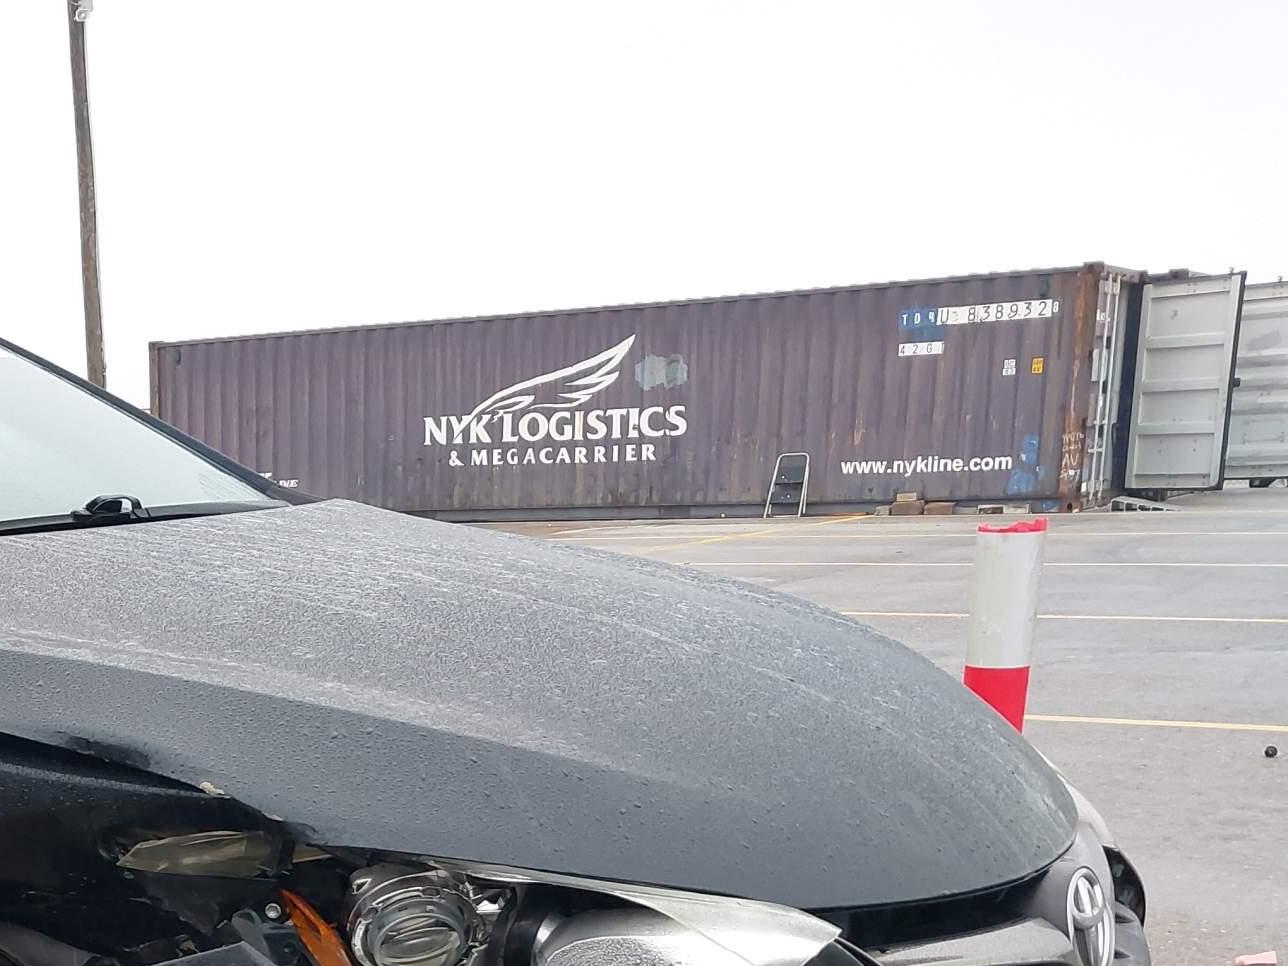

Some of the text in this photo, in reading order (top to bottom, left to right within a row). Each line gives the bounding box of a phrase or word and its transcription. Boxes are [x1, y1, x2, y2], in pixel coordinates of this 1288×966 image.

[423, 405, 687, 445] NYK LOGISTICS
[449, 444, 656, 466] & MEGACARRIER
[841, 456, 1012, 477] www.nykline.com
